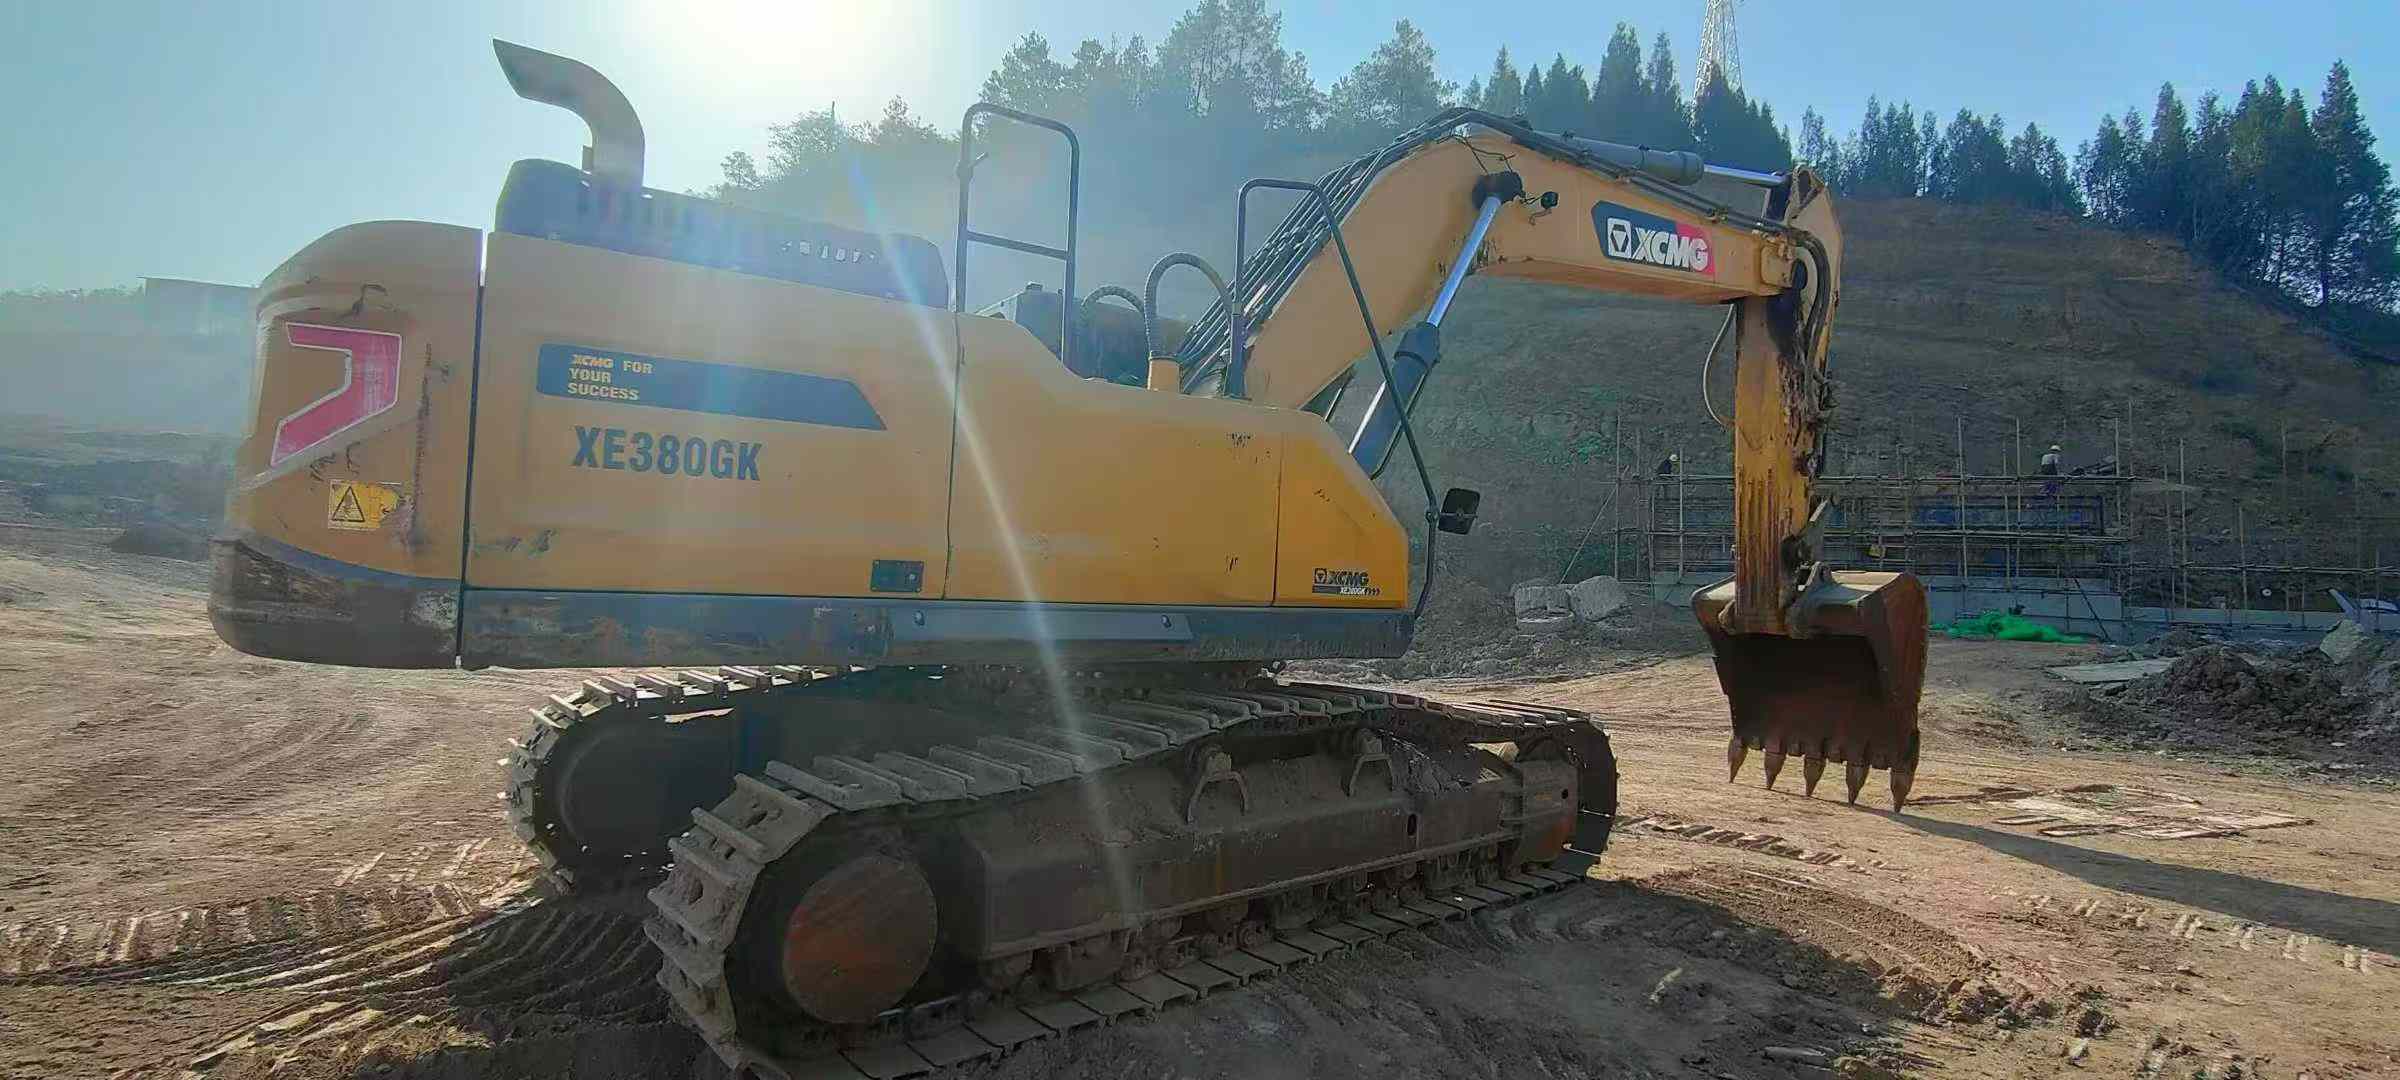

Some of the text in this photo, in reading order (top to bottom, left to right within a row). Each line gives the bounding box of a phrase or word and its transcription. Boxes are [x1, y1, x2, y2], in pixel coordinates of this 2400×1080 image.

[1632, 227, 1708, 271] XCMG
[569, 368, 611, 383] YOUR
[623, 360, 653, 374] FOR
[568, 383, 639, 400] SUCCESS
[572, 425, 762, 481] XE380GK
[1328, 570, 1369, 587] XCMG
